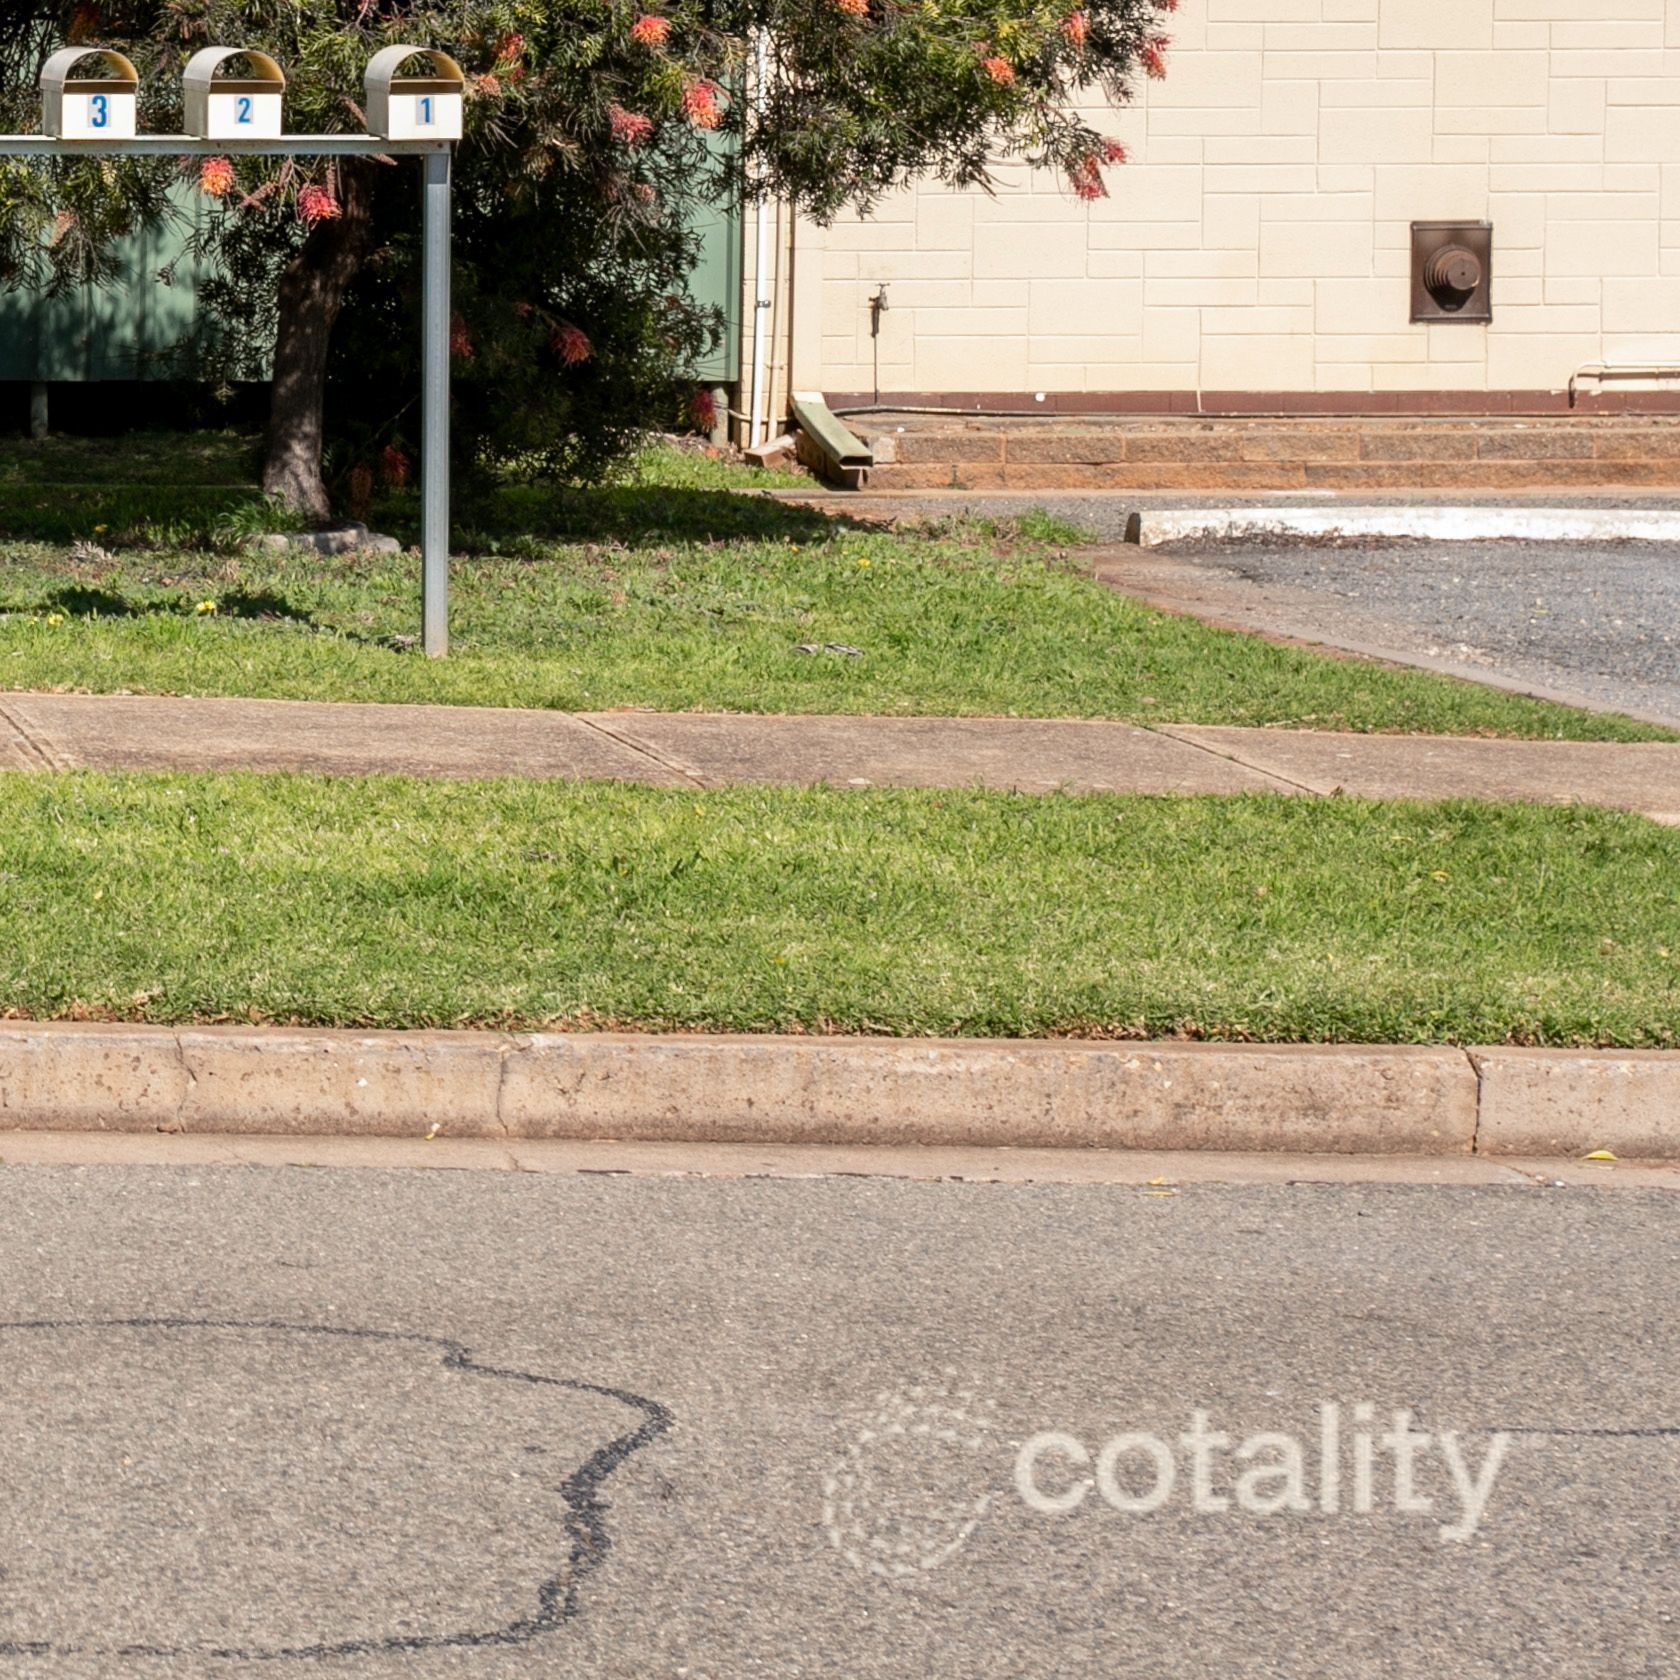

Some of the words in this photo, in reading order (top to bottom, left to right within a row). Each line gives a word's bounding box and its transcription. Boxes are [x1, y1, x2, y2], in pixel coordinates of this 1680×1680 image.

[91, 94, 107, 128] 3
[238, 96, 251, 123] 2
[420, 97, 431, 123] 1
